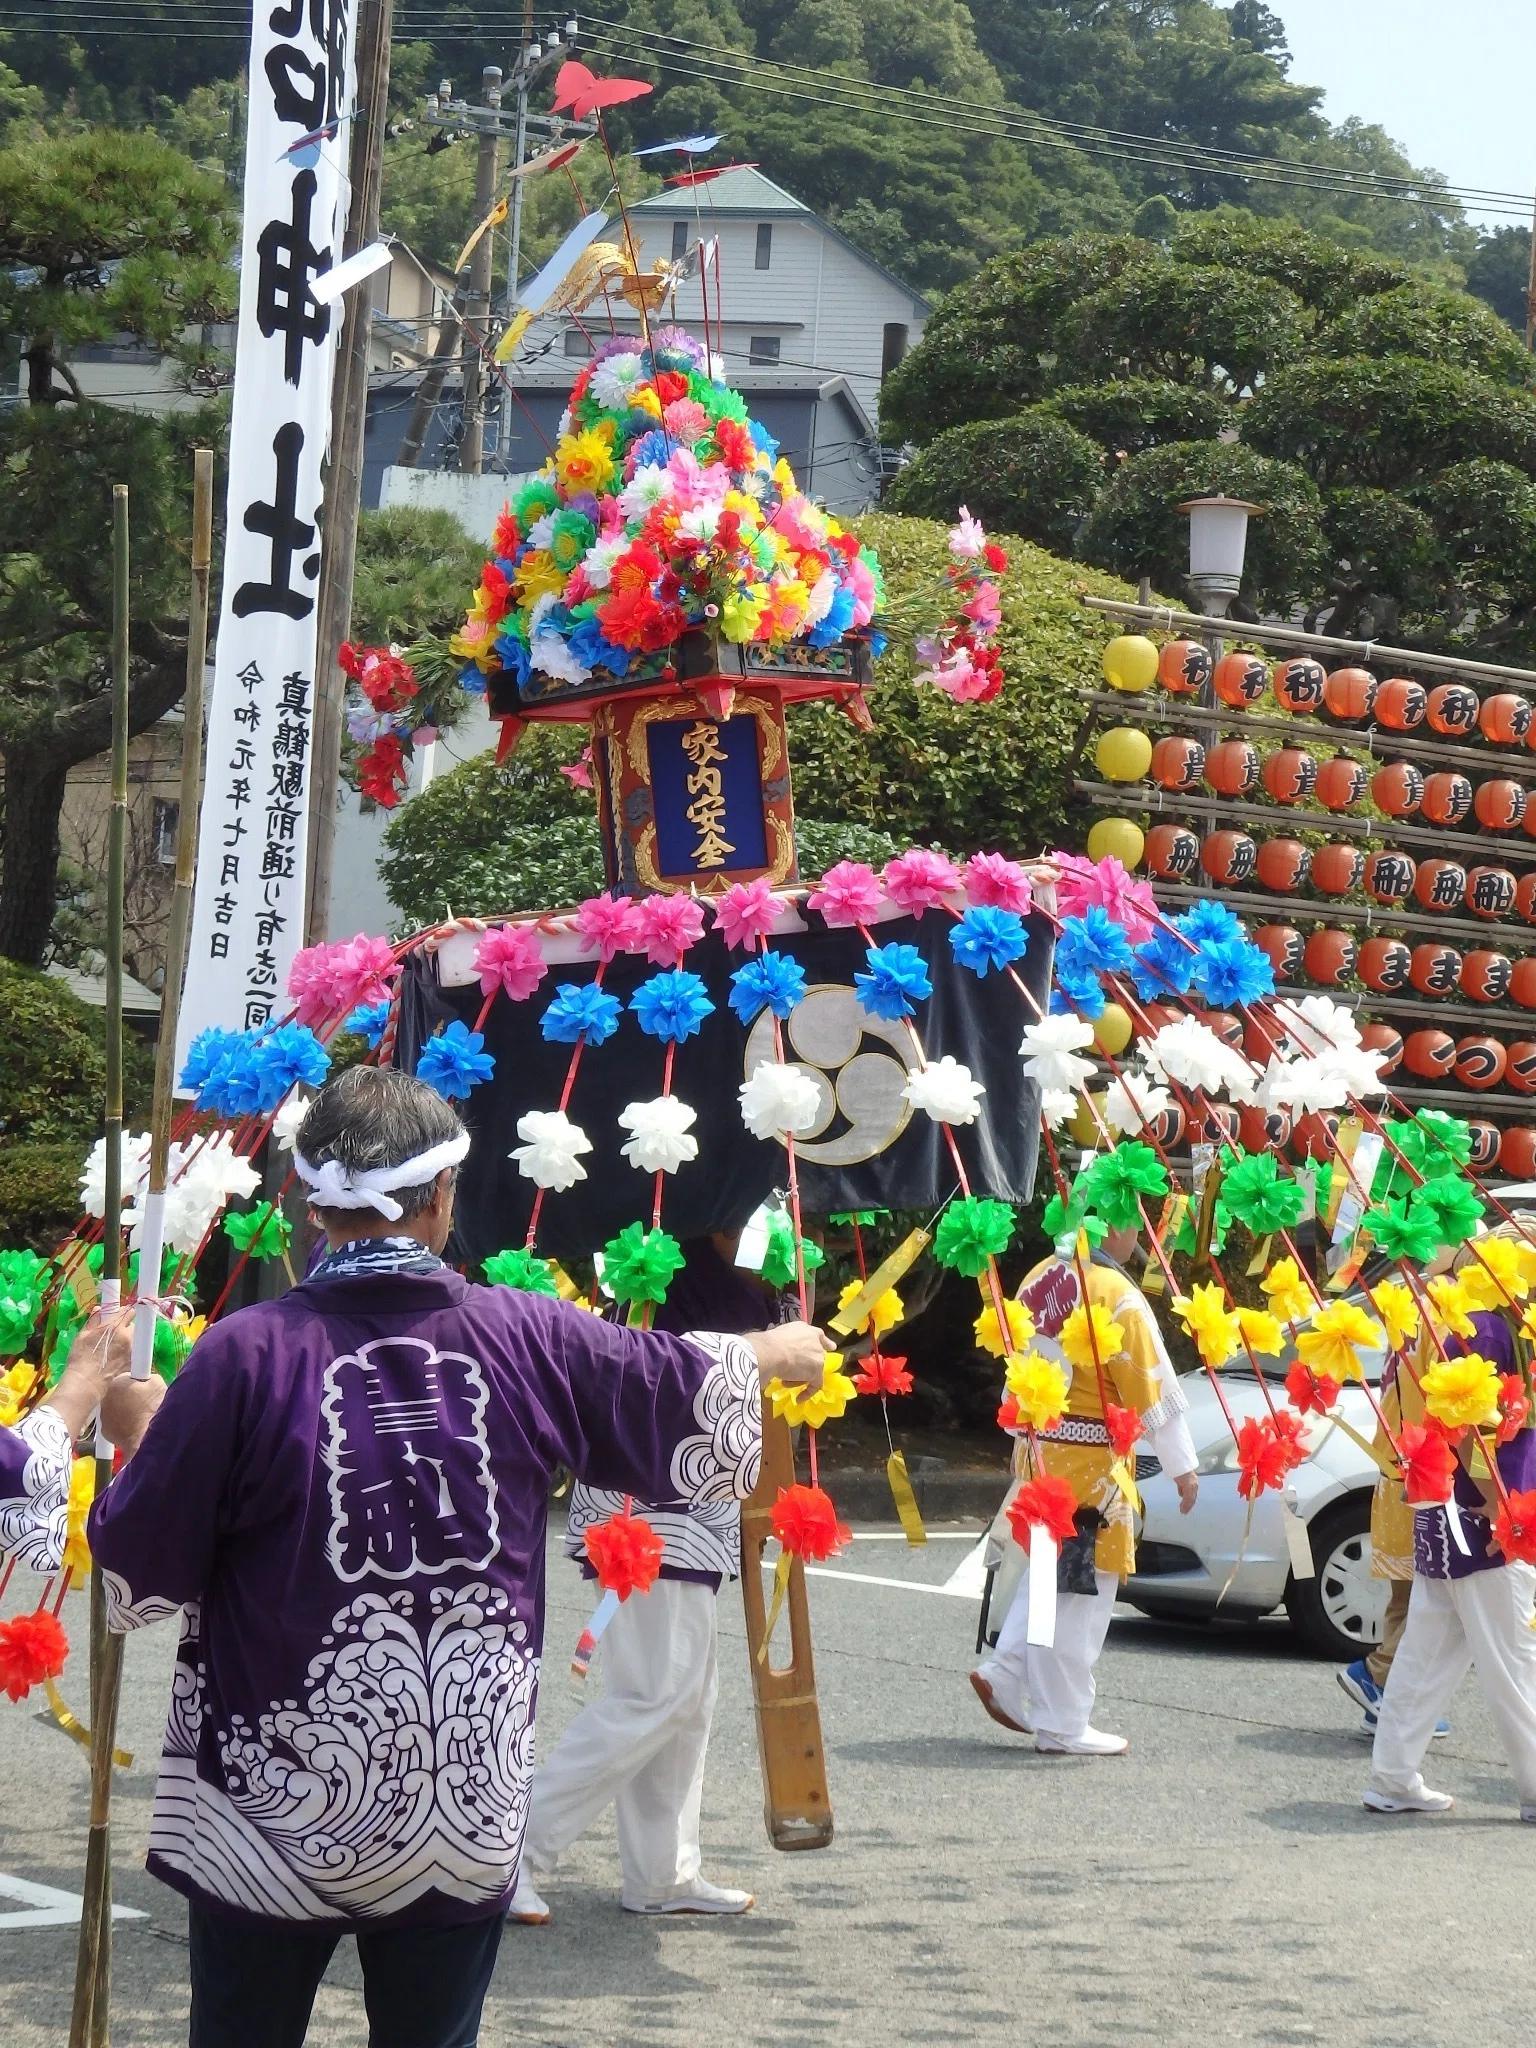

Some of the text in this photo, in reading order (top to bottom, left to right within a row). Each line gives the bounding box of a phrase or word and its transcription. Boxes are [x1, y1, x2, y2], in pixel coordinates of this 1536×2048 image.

[1283, 663, 1326, 704] 祝
[1437, 688, 1477, 729] 祝
[681, 720, 736, 868] 家内安全
[1371, 855, 1415, 899] 船
[1473, 871, 1516, 914] 船
[1425, 950, 1463, 991] ま
[1456, 1045, 1499, 1079] つ
